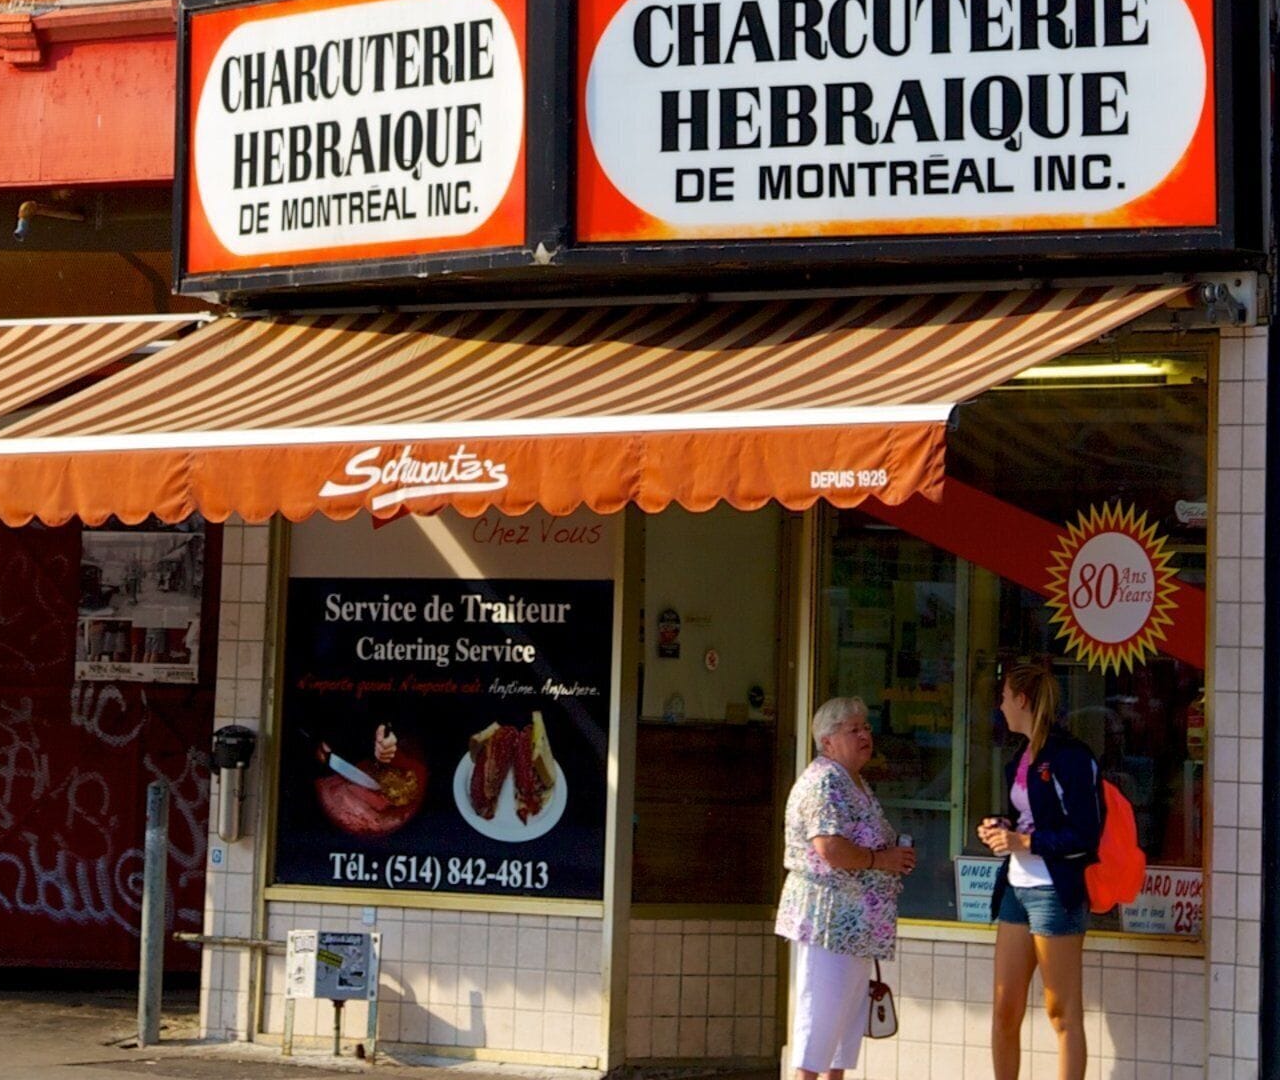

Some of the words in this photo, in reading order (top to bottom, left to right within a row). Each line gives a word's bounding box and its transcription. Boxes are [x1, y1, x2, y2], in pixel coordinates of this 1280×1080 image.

[221, 17, 494, 114] CHARCUTERIE
[659, 70, 1130, 152] HEBRAIQUE
[232, 103, 483, 190] HEBRAIQUE
[675, 166, 735, 203] DE
[757, 154, 1014, 200] MONTRÉAL
[1033, 153, 1125, 192] INC.
[239, 201, 270, 236] DE
[281, 184, 416, 232] MONTRÉAL
[428, 180, 479, 217] INC.
[318, 444, 510, 511] Schwartz's
[810, 470, 855, 489] DEPUIS
[856, 468, 888, 488] 1928
[472, 517, 529, 545] Chez
[540, 515, 602, 545] Vous
[1072, 562, 1119, 610] 80
[1120, 567, 1147, 584] Ans
[325, 593, 417, 623] Service
[424, 595, 454, 623] de
[461, 594, 572, 624] Traiteur
[1118, 584, 1153, 603] Years
[356, 636, 450, 667] Catering
[455, 637, 536, 664] Service
[488, 677, 537, 699] Anytime.
[541, 677, 601, 701] Anywhere.
[329, 852, 378, 881] Tél.:
[385, 854, 441, 890] (514)
[447, 856, 549, 890] 842-4813
[960, 864, 992, 878] DINDE
